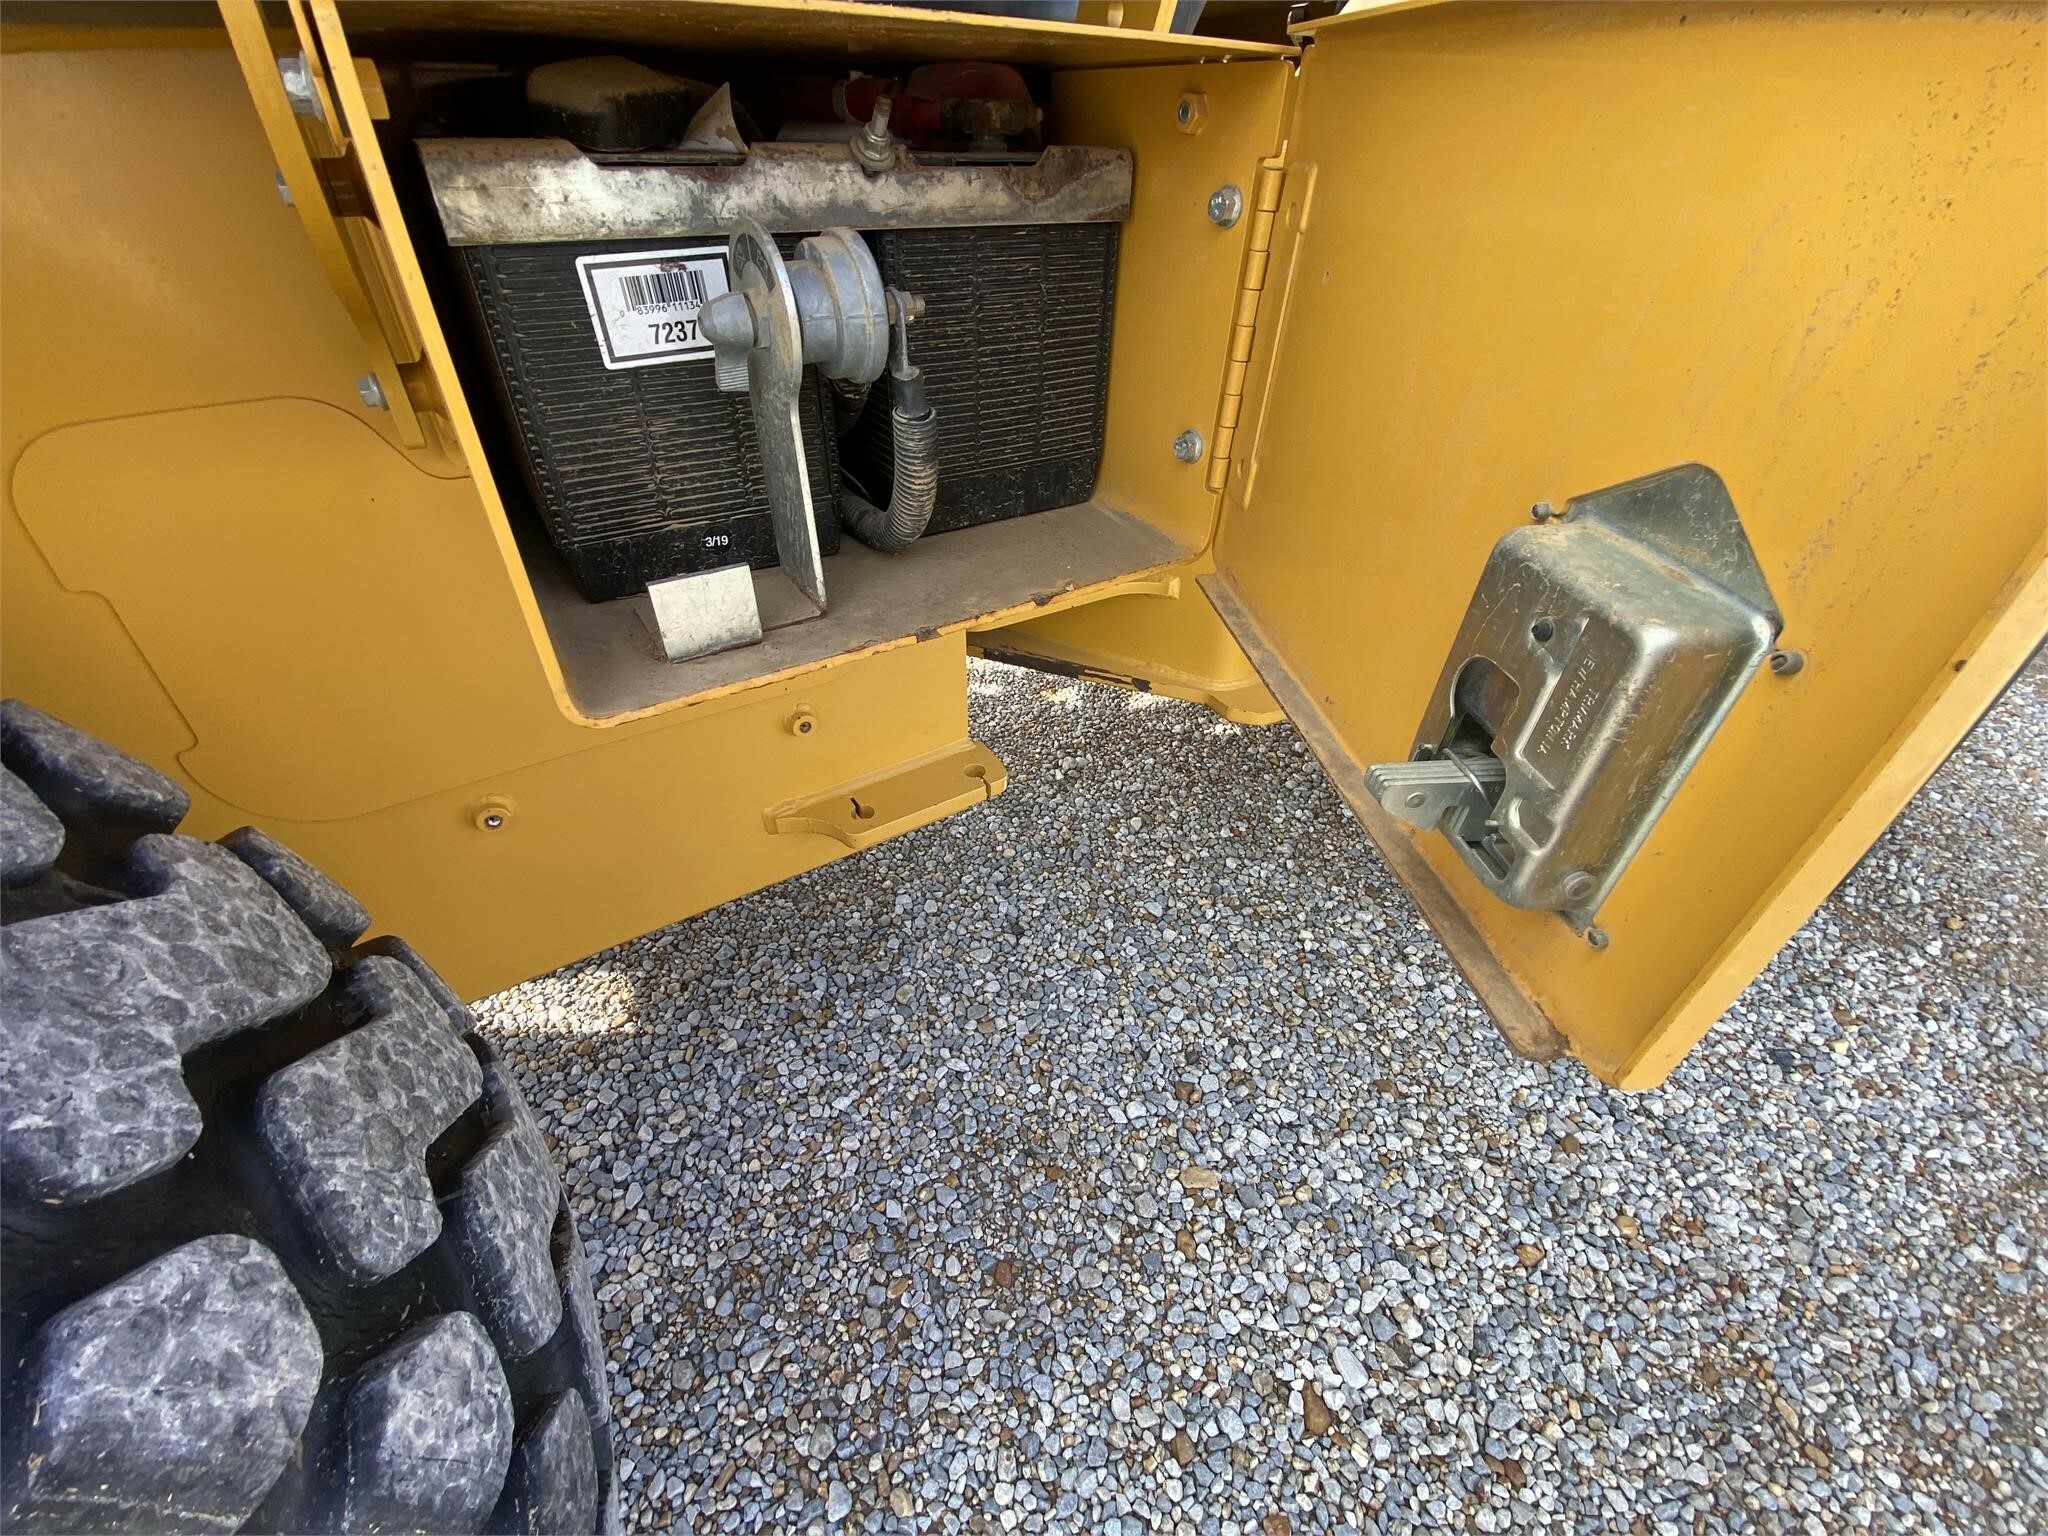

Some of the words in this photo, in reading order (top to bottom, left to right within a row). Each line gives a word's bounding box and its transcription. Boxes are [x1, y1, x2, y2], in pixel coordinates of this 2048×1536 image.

[636, 304, 667, 315] 83996
[672, 301, 701, 312] 11134
[648, 319, 698, 345] 7237
[705, 535, 729, 547] 3/19
[1545, 680, 1584, 742] HAMPTON
